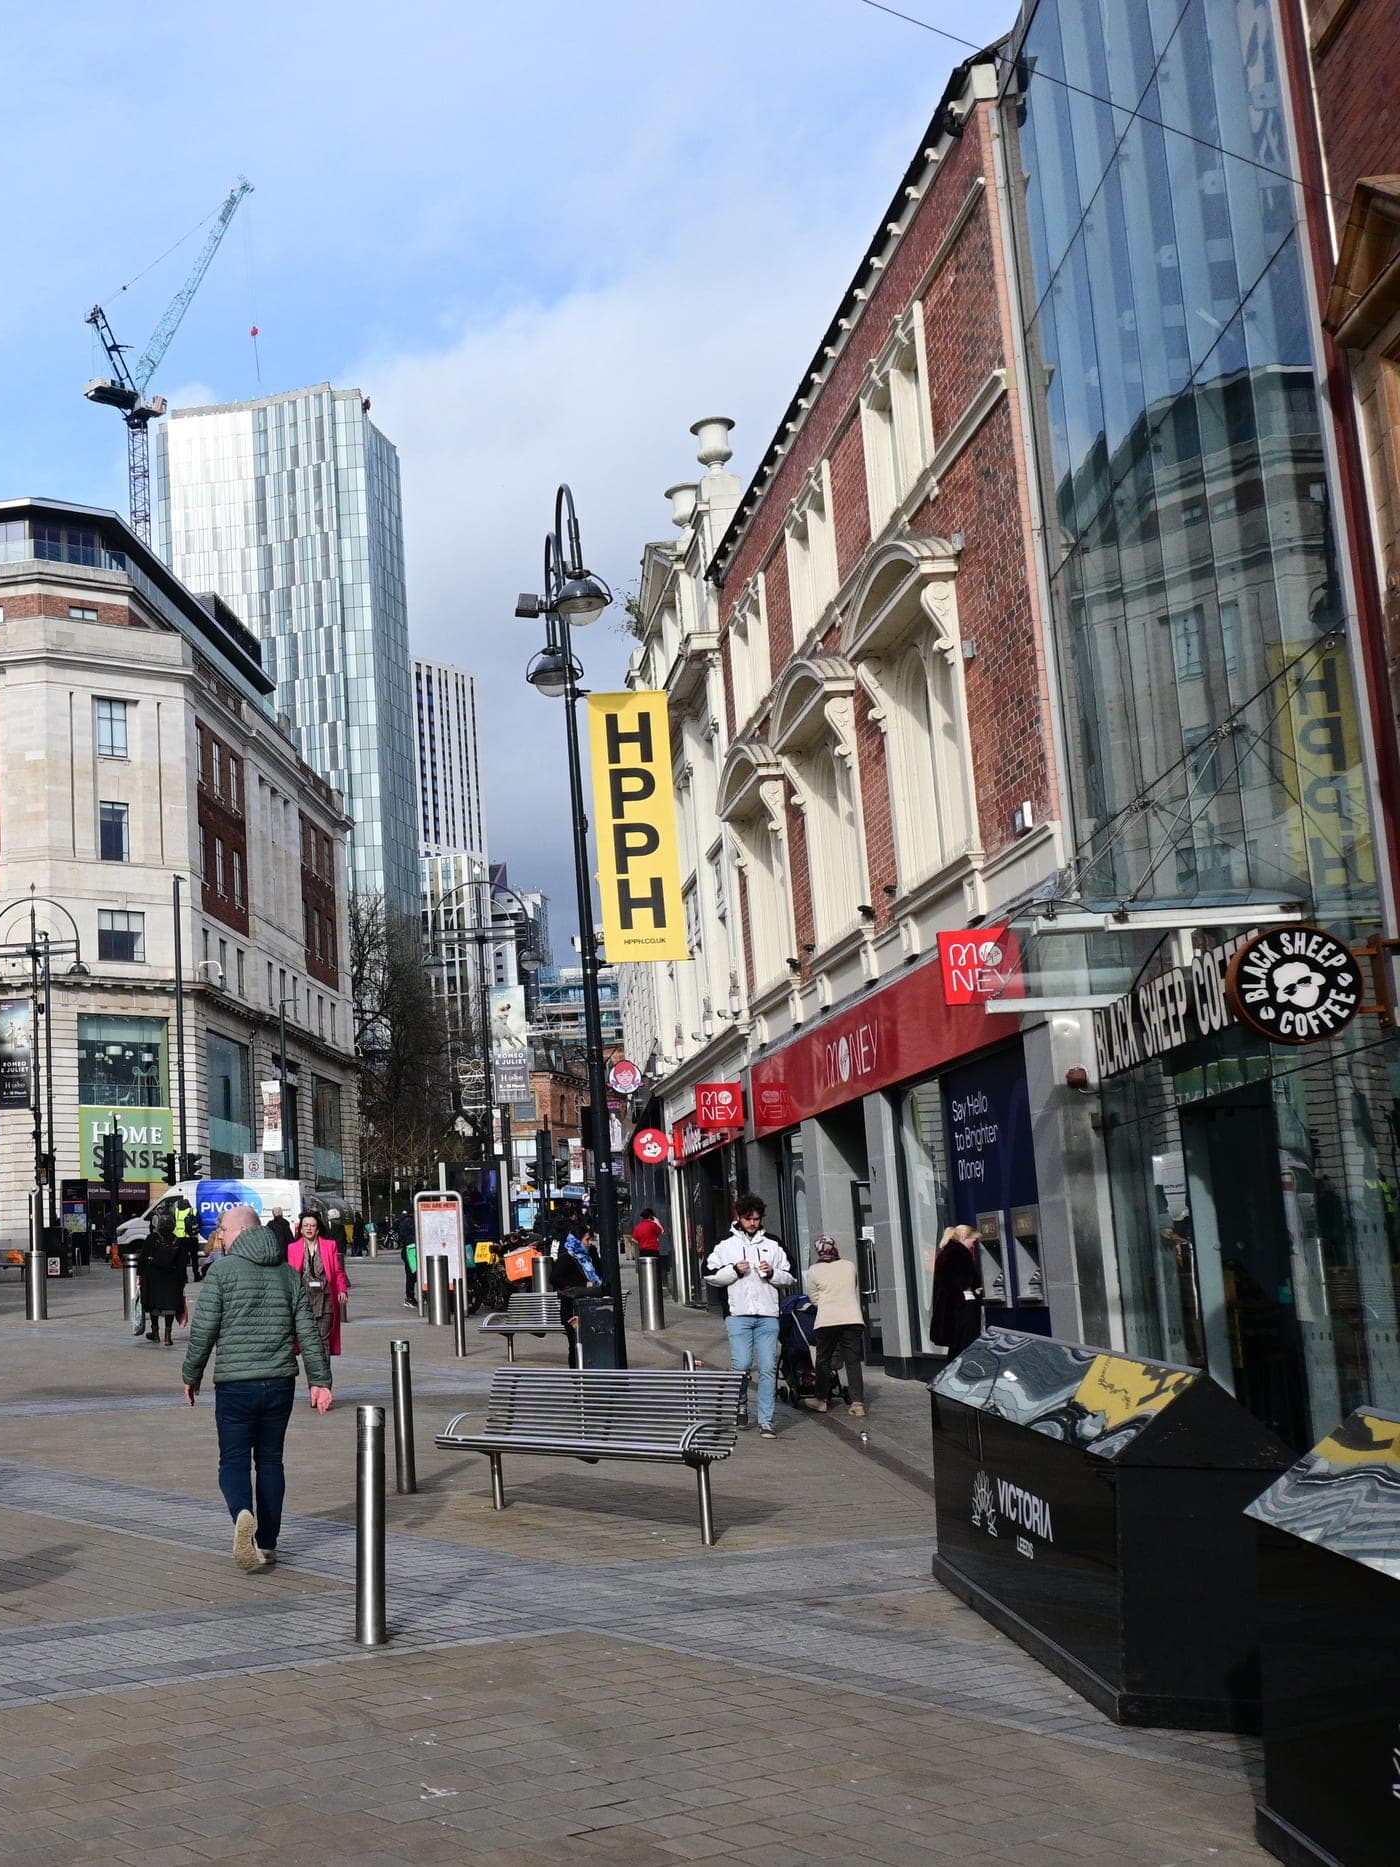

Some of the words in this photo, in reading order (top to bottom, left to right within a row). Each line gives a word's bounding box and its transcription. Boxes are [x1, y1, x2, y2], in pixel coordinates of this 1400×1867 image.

[605, 712, 666, 929] HPPH
[624, 937, 667, 945] HPPH.CO.UK
[1242, 939, 1282, 1004] BLACK
[1279, 931, 1348, 968] SHEEP
[1095, 993, 1141, 1079] BLACK
[1139, 966, 1188, 1059] SHEEP
[1280, 988, 1357, 1037] COFFEE
[702, 1106, 738, 1120] NEY
[952, 1101, 966, 1124] Say
[966, 1091, 988, 1117] Hello
[955, 1131, 965, 1151] to
[965, 1122, 999, 1152] Brighter
[93, 1146, 165, 1168] SNSE
[958, 1158, 985, 1183] Money
[997, 1478, 1053, 1543] VICTORIA
[1016, 1535, 1034, 1560] LEEDS
